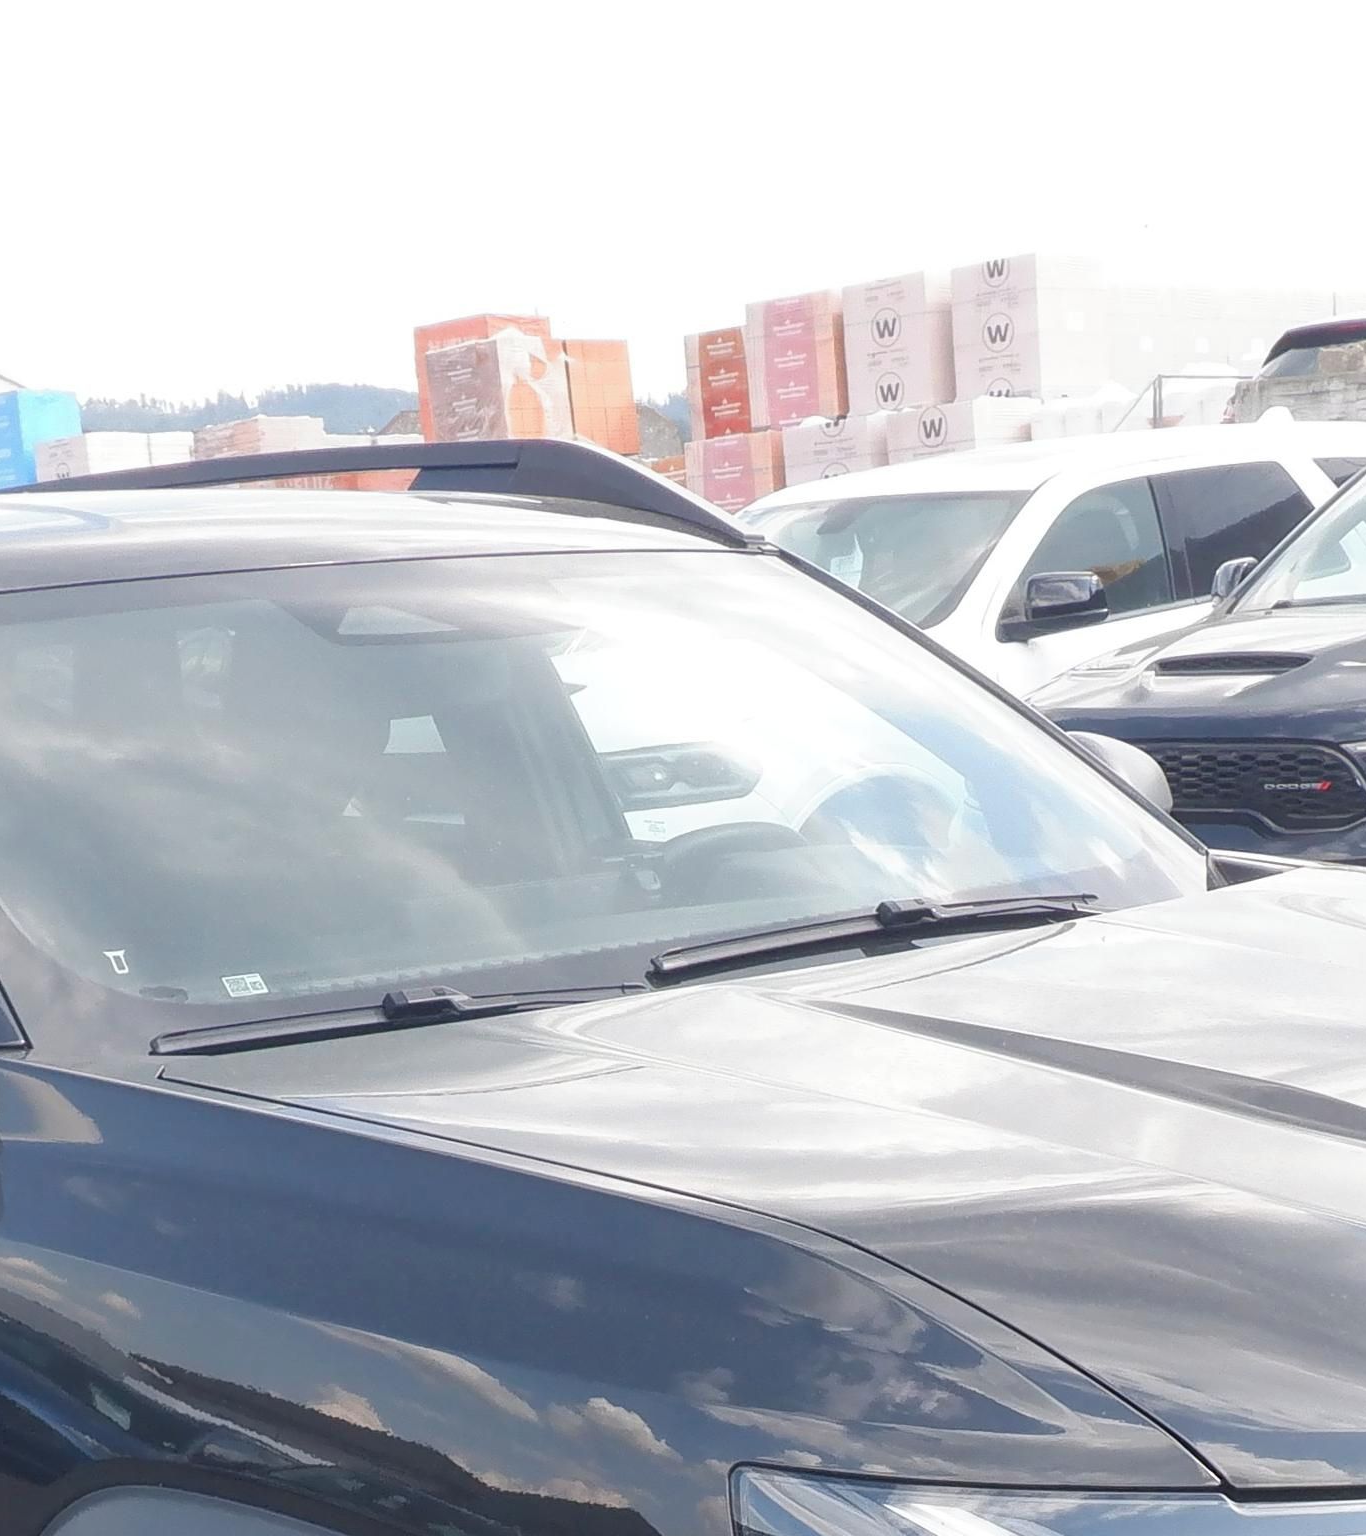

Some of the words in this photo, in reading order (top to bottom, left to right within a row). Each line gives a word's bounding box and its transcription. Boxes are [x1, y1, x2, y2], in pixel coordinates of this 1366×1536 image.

[875, 317, 897, 339] W
[987, 322, 1010, 344] W
[879, 382, 900, 403] W
[922, 417, 943, 439] W
